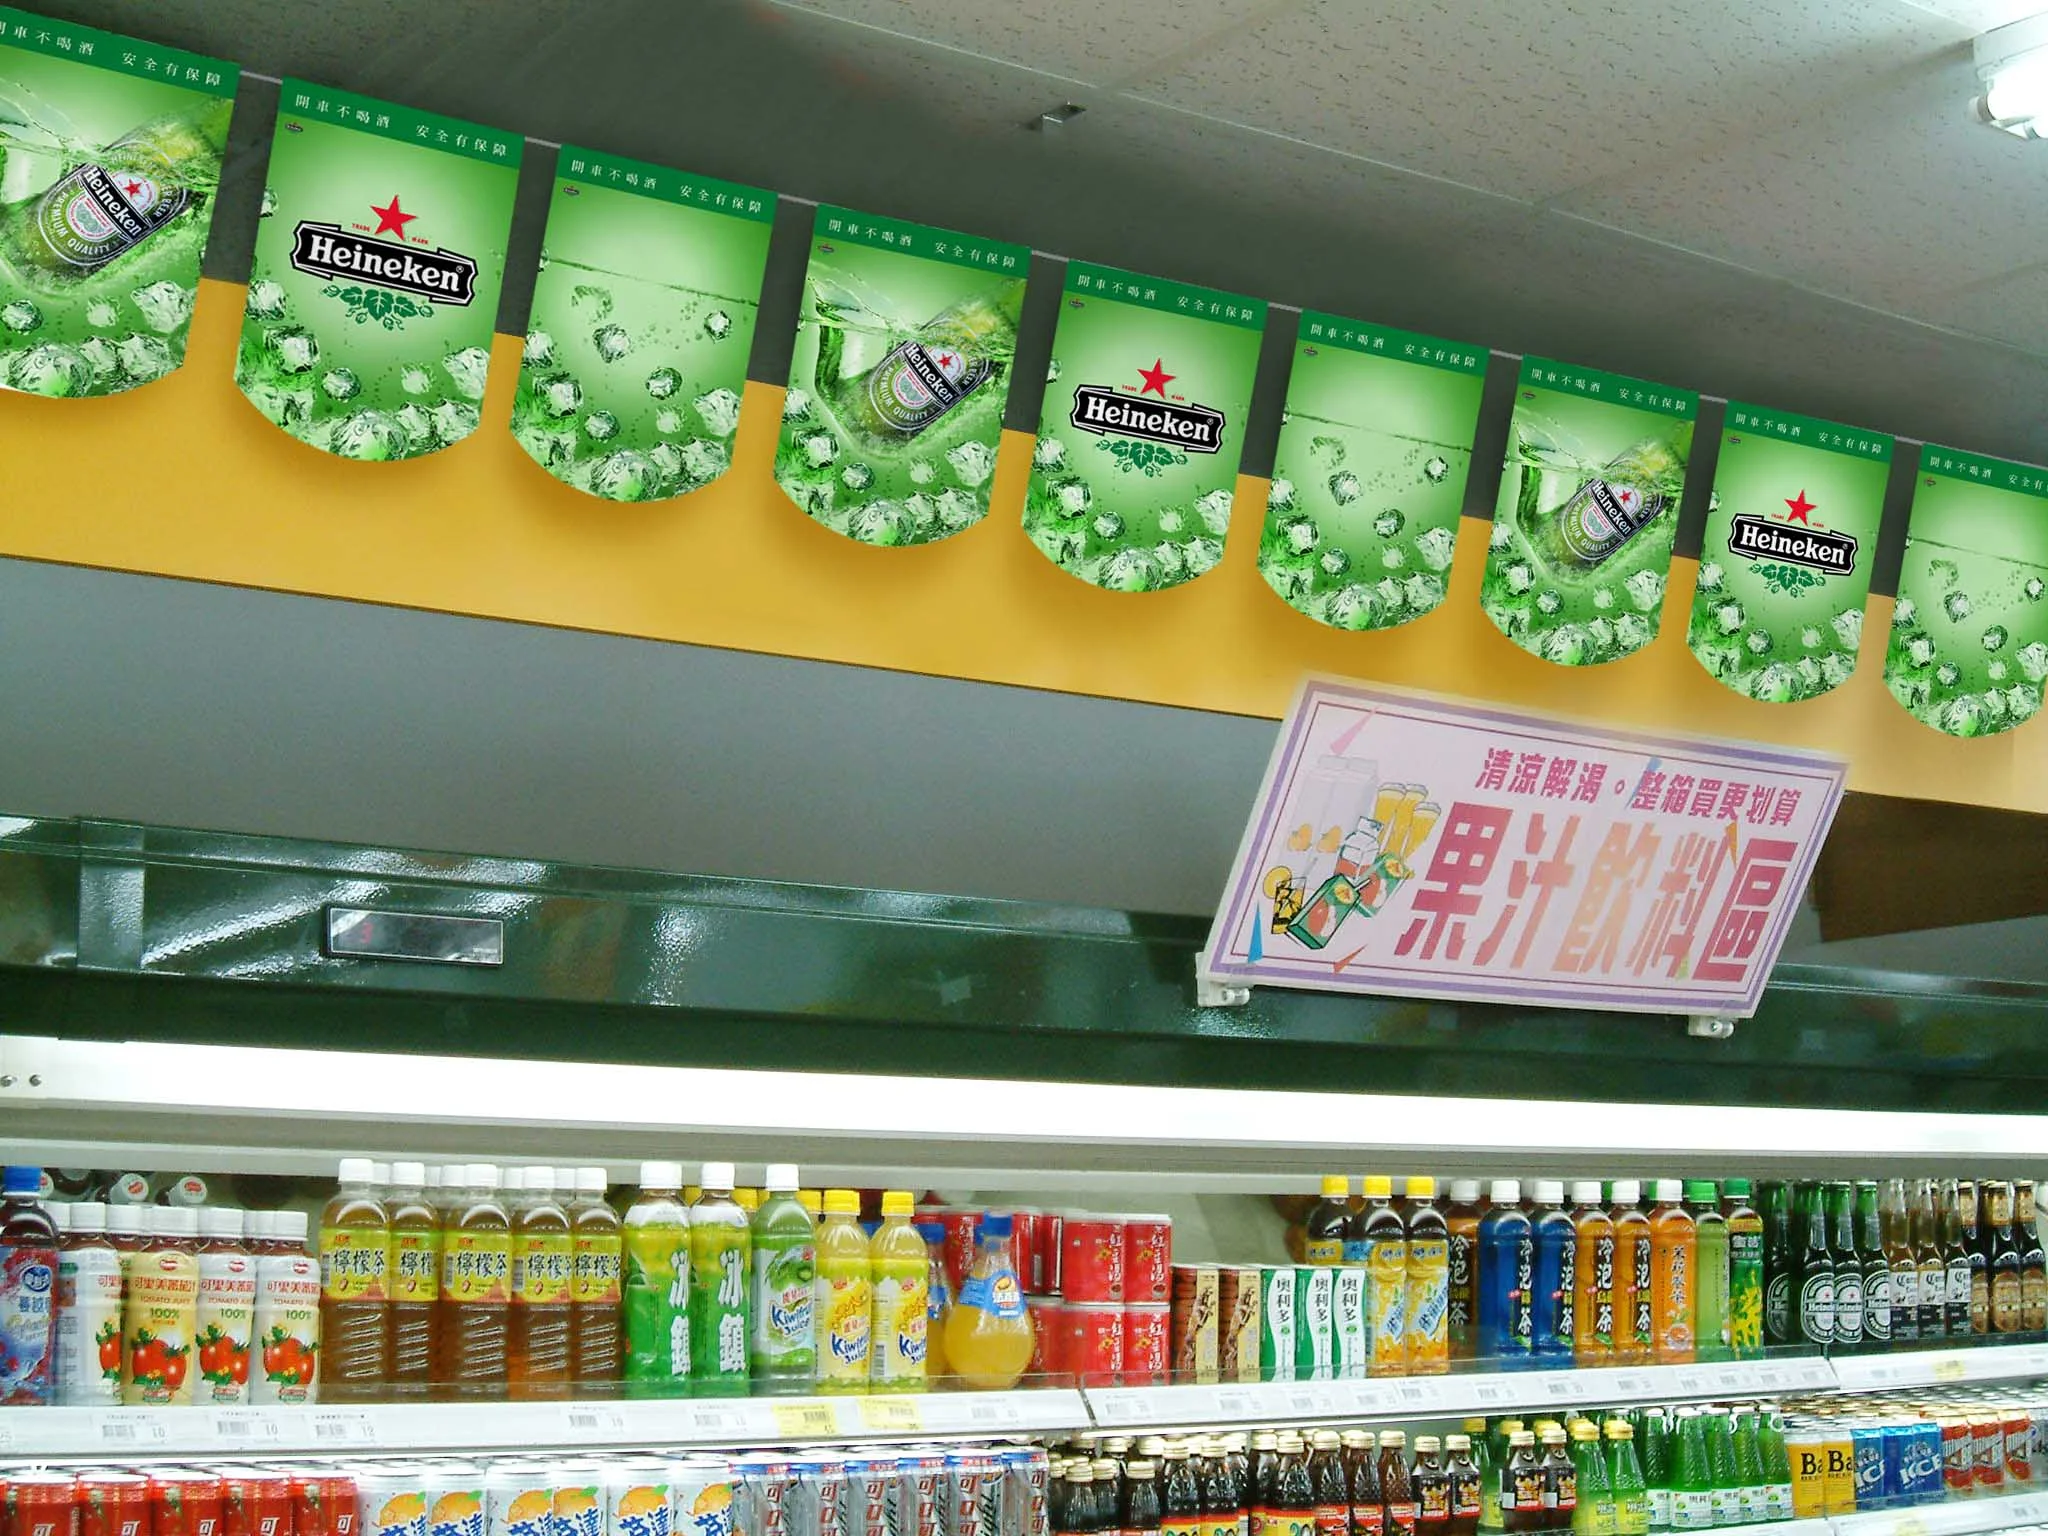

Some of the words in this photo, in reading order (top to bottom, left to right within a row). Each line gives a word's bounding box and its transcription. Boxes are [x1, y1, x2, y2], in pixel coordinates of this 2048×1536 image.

[122, 51, 221, 86] 安全有保障
[295, 94, 391, 129] 開車不喝酒
[416, 124, 507, 157] 安全有保障
[82, 165, 142, 238] Heineken
[571, 159, 657, 190] 開車不喝酒
[679, 184, 761, 214] 安全有保障
[67, 238, 111, 256] QUALITY
[352, 222, 371, 233] TRADE
[411, 236, 429, 246] MARK
[828, 219, 912, 248] 開車不喝酒
[935, 241, 1016, 269] 安全有保障
[307, 234, 460, 292] Heineken
[1077, 274, 1157, 302] 開車不喝酒
[1176, 295, 1254, 321] 安全有保障
[1310, 323, 1385, 350] 開車不喝酒
[1404, 343, 1476, 368] 安全有保障
[905, 343, 954, 404] Heineken
[1531, 367, 1600, 393] 開車不喝酒
[1619, 388, 1687, 412] 安全有保障
[892, 406, 928, 421] QUALITY
[1084, 396, 1211, 442] Heineken
[1735, 412, 1801, 436] 開車不喝酒
[1818, 431, 1883, 455] 安全有保障
[2008, 474, 2048, 492] 安全有
[1592, 480, 1632, 535] Heineken
[1740, 524, 1845, 565] Heineken
[1394, 800, 1800, 982] 果汁飲料區
[333, 1249, 385, 1276] 檸檬茶
[457, 1251, 508, 1278] 檸檬茶
[149, 1307, 180, 1319] 100%
[220, 1308, 246, 1319] 100%
[285, 1309, 312, 1320] 100%
[1276, 1278, 1292, 1324] 奧利多
[1314, 1278, 1329, 1323] 奧利多
[1342, 1278, 1357, 1322] 奧利多
